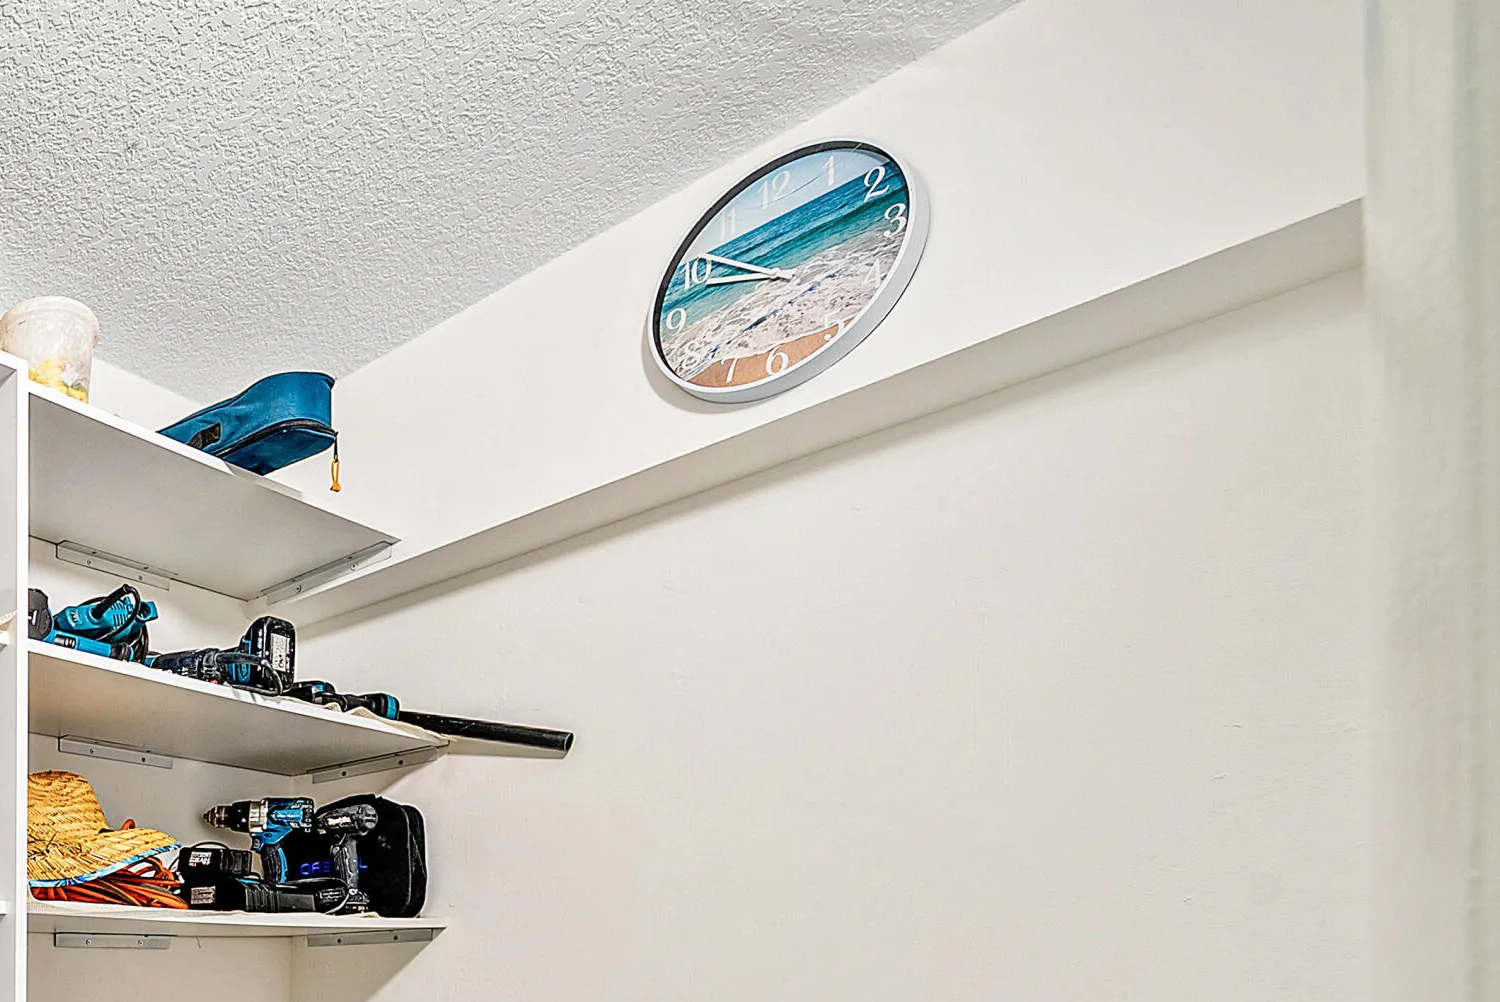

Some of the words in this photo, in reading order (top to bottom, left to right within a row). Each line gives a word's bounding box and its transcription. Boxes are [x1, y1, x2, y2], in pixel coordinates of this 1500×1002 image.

[822, 155, 835, 187] 1
[863, 166, 889, 202] 2
[758, 170, 791, 210] 12
[883, 203, 906, 237] 3
[680, 256, 712, 290] 10
[666, 307, 687, 335] 9
[824, 312, 845, 342] 5
[721, 356, 738, 383] 7
[765, 347, 789, 377] 6
